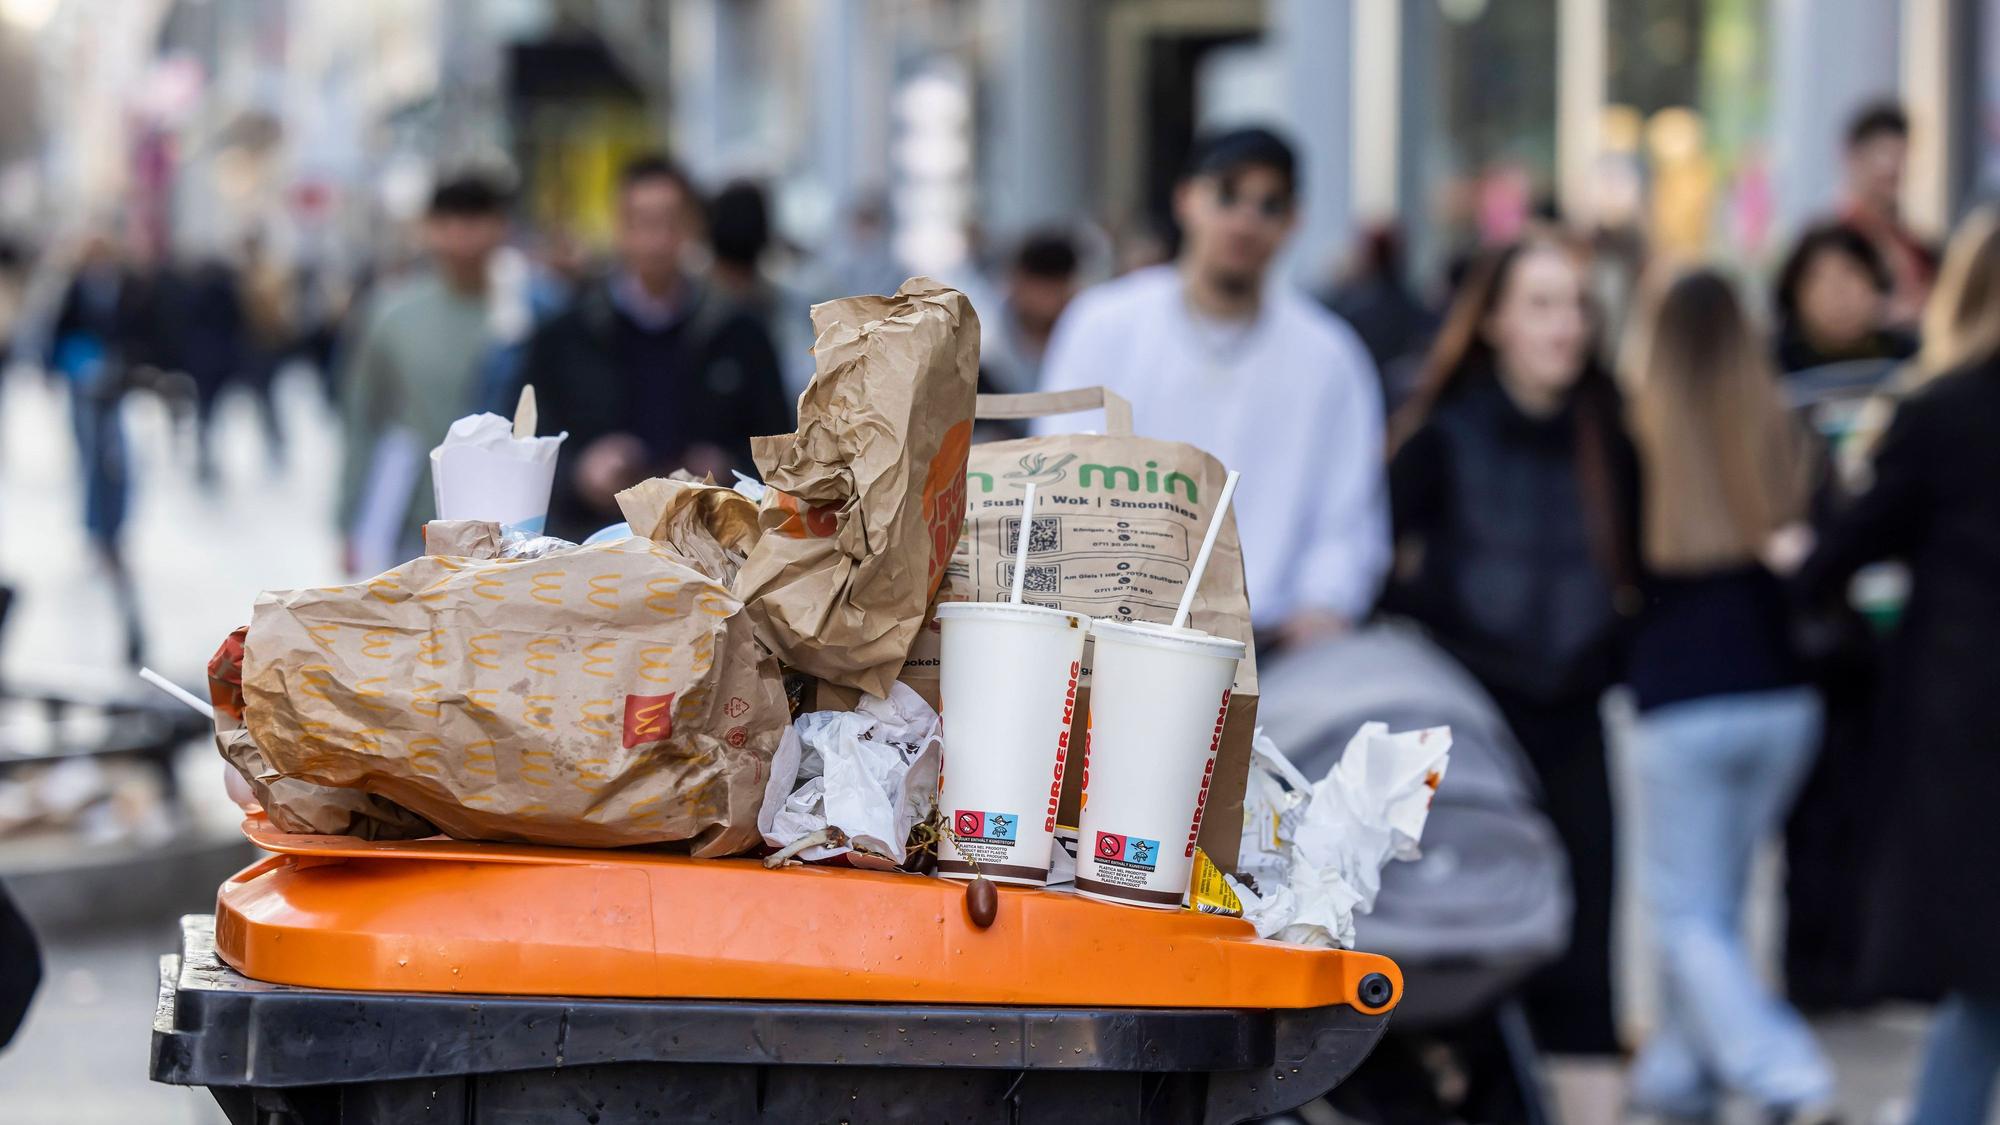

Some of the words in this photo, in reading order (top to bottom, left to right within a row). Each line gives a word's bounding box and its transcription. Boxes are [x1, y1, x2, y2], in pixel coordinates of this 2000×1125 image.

[1079, 461, 1198, 504] min
[983, 498, 1026, 507] Sush
[1052, 495, 1090, 505] Wok
[1110, 498, 1198, 520] Smoothies
[1149, 574, 1184, 585] Stuttgart
[1044, 730, 1069, 833] BURGER
[1062, 660, 1080, 725] KING
[1184, 757, 1215, 858] BURGER
[1210, 688, 1231, 752] KING
[1096, 872, 1114, 880] PLASTICO
[1125, 878, 1148, 886] PRODUCTO
[1100, 877, 1117, 885] PLASTIC
[1124, 869, 1147, 877] PRODOTTO
